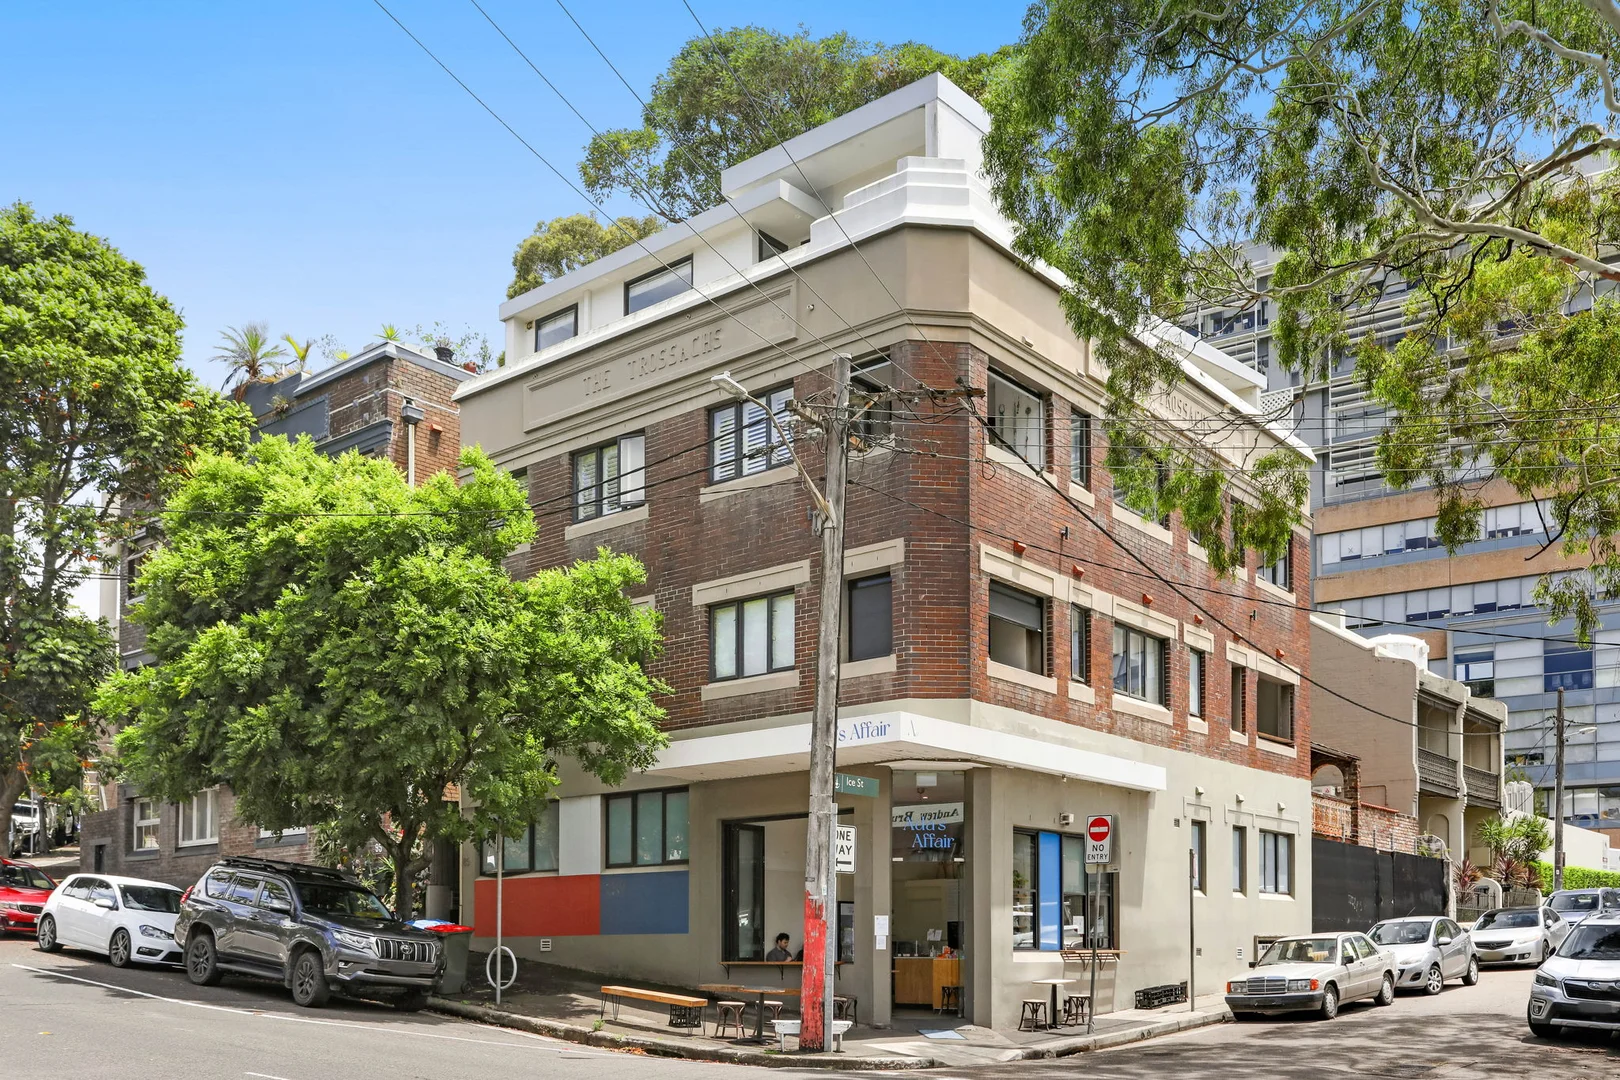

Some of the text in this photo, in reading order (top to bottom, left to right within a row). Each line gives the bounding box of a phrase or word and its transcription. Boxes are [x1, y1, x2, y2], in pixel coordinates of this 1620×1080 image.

[583, 328, 722, 396] THE TROSSACHS
[850, 721, 891, 740] Affair
[846, 777, 864, 788] Ice St
[912, 832, 955, 848] Affair
